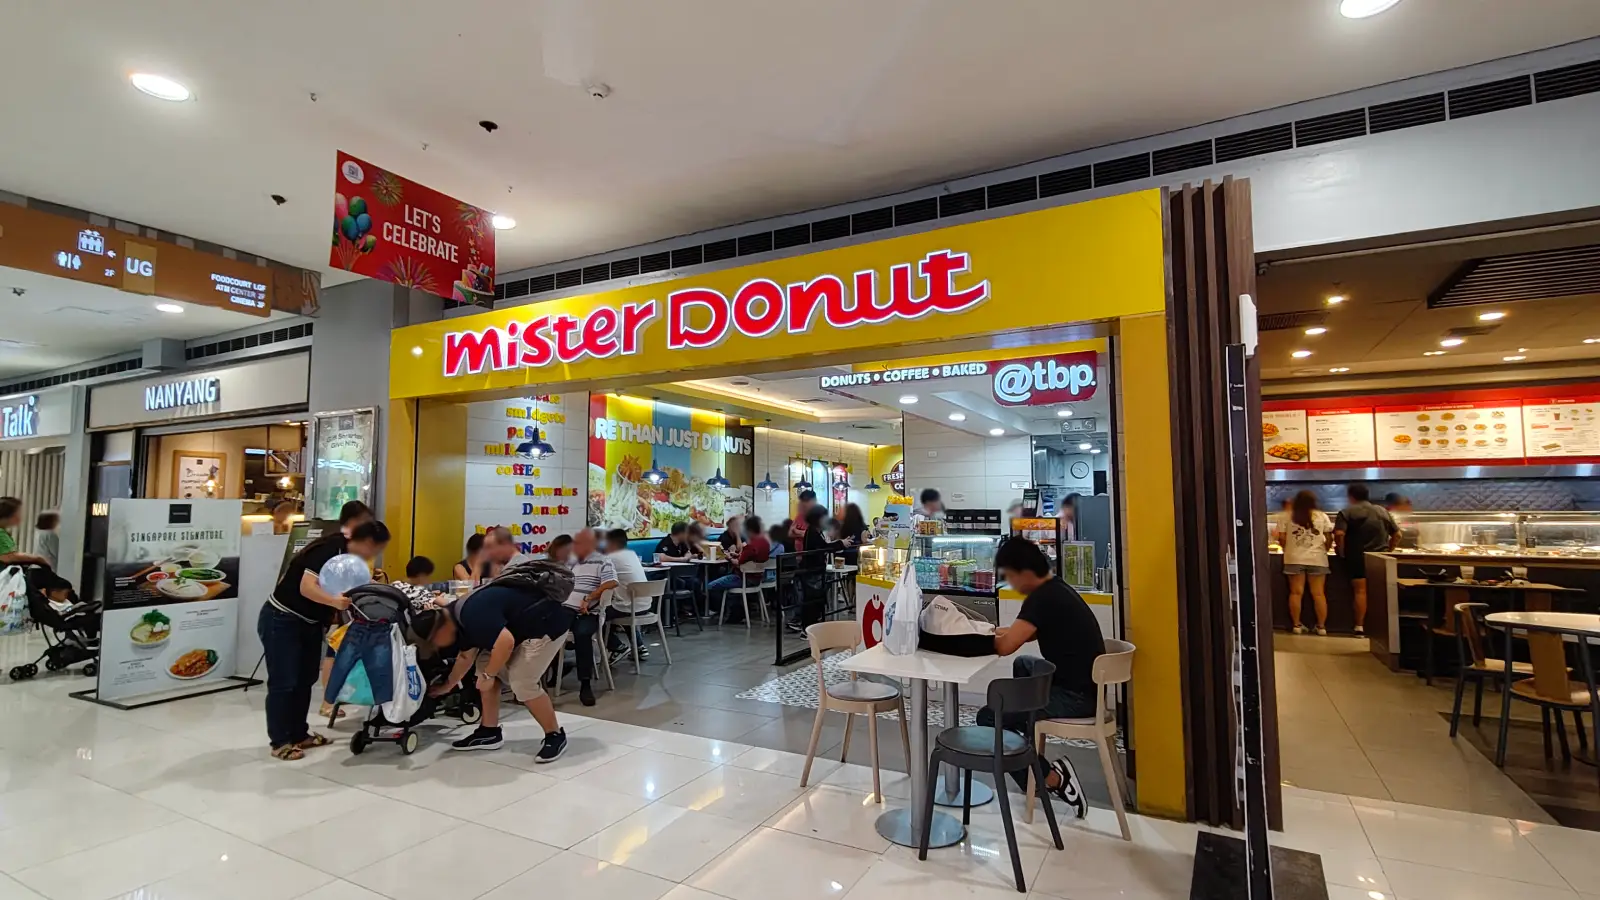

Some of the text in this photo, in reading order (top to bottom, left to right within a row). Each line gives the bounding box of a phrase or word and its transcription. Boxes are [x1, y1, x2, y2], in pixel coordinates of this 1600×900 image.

[404, 203, 441, 234] LET'S
[382, 221, 459, 264] CELEBRATE
[126, 257, 154, 277] UG
[210, 273, 252, 288] FOODCOURT
[821, 362, 988, 388] DONUTS COFFEE BAKED
[145, 376, 217, 411] NANYANG
[618, 421, 664, 446] THAN
[665, 427, 700, 449] JUST
[701, 431, 752, 456] DONUTS
[522, 503, 569, 516] Donuts
[130, 530, 224, 542] SINGAPORE SIGNATURE
